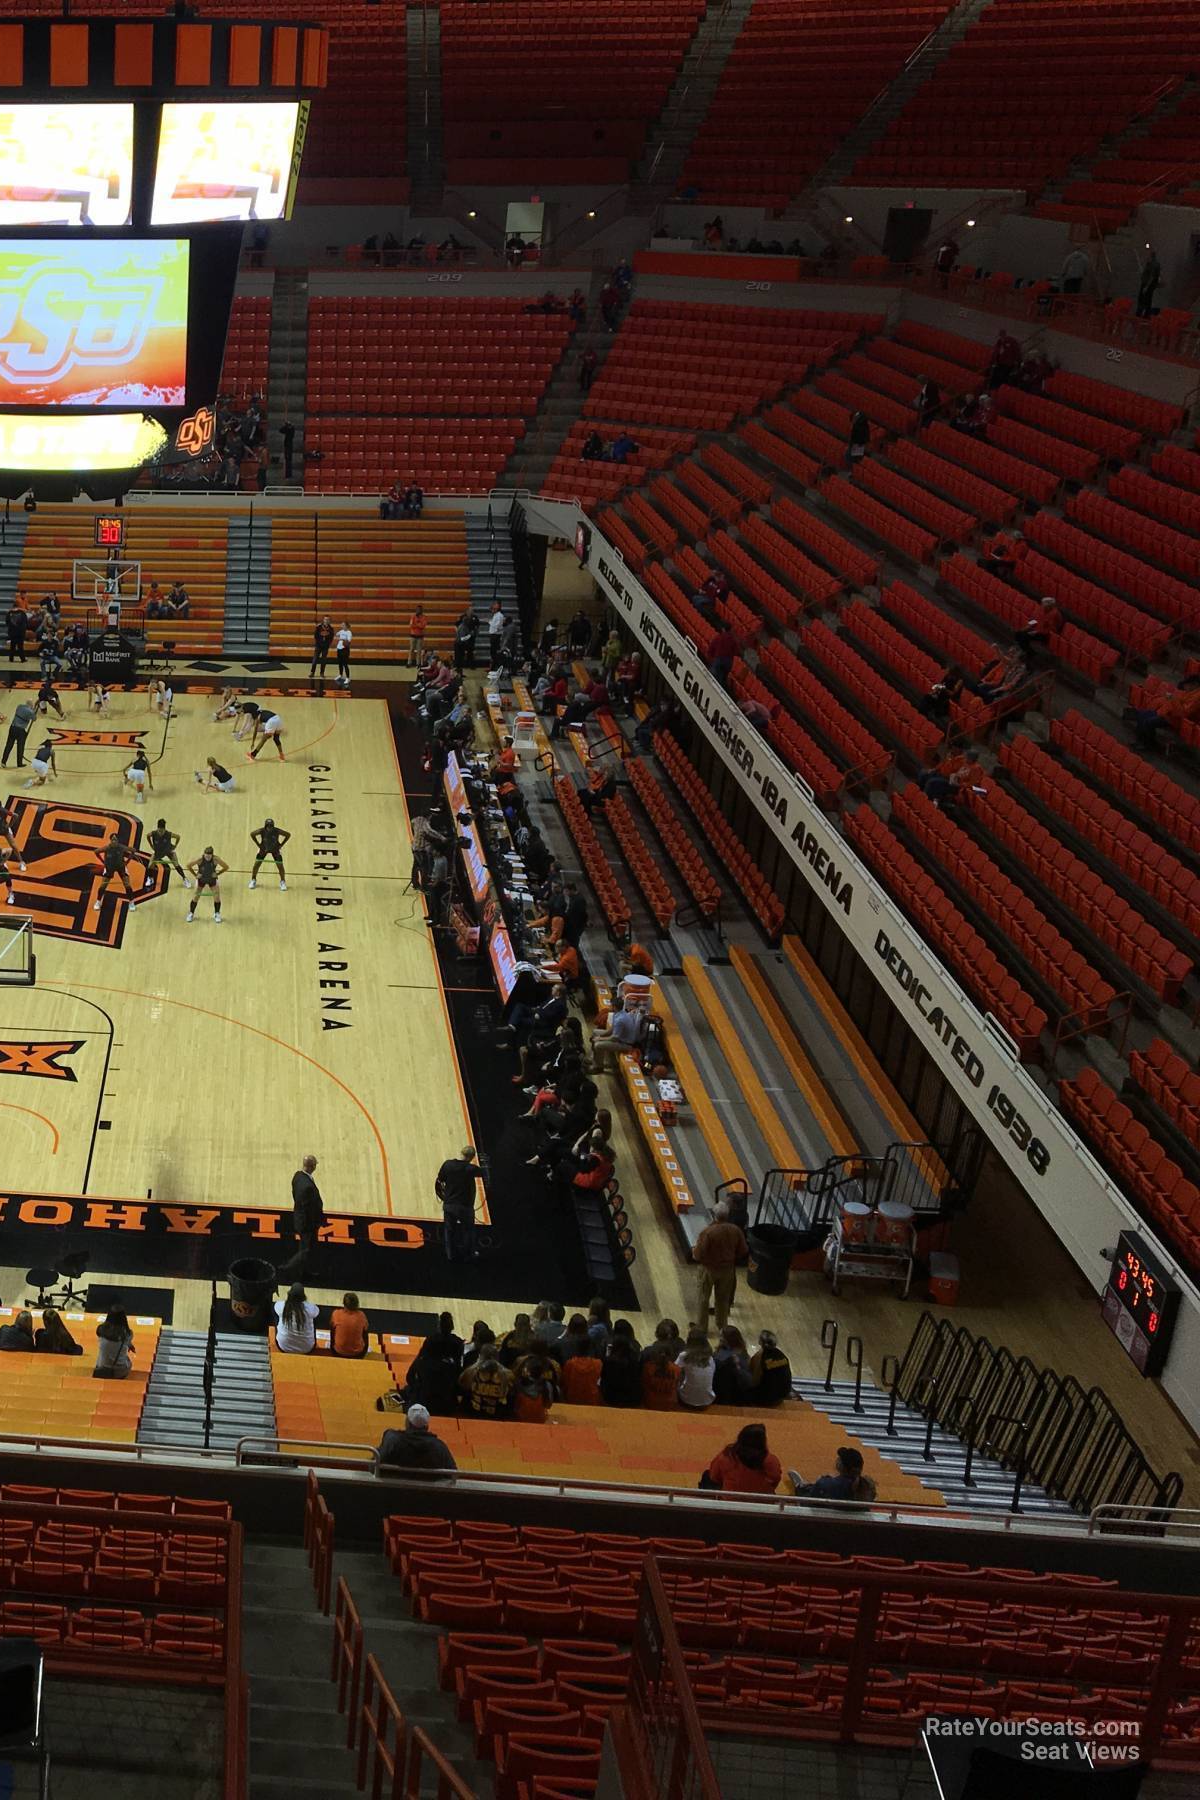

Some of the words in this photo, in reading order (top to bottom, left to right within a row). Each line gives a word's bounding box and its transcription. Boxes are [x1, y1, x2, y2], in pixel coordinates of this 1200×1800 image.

[291, 104, 309, 177] Hertz
[176, 408, 216, 456] OSU
[101, 527, 118, 543] 30
[598, 558, 625, 600] WELCOME
[624, 590, 634, 611] TO
[640, 612, 682, 680] HISTORIC
[683, 670, 788, 826] GALLAGHER-IBA
[791, 821, 854, 915] ARENA
[874, 929, 984, 1088] DEDICATED
[987, 1085, 1051, 1177] 1938
[317, 942, 353, 1031] ARENA
[1118, 1271, 1129, 1291] 0
[1132, 1292, 1140, 1307] 1
[1147, 1312, 1159, 1334] 0
